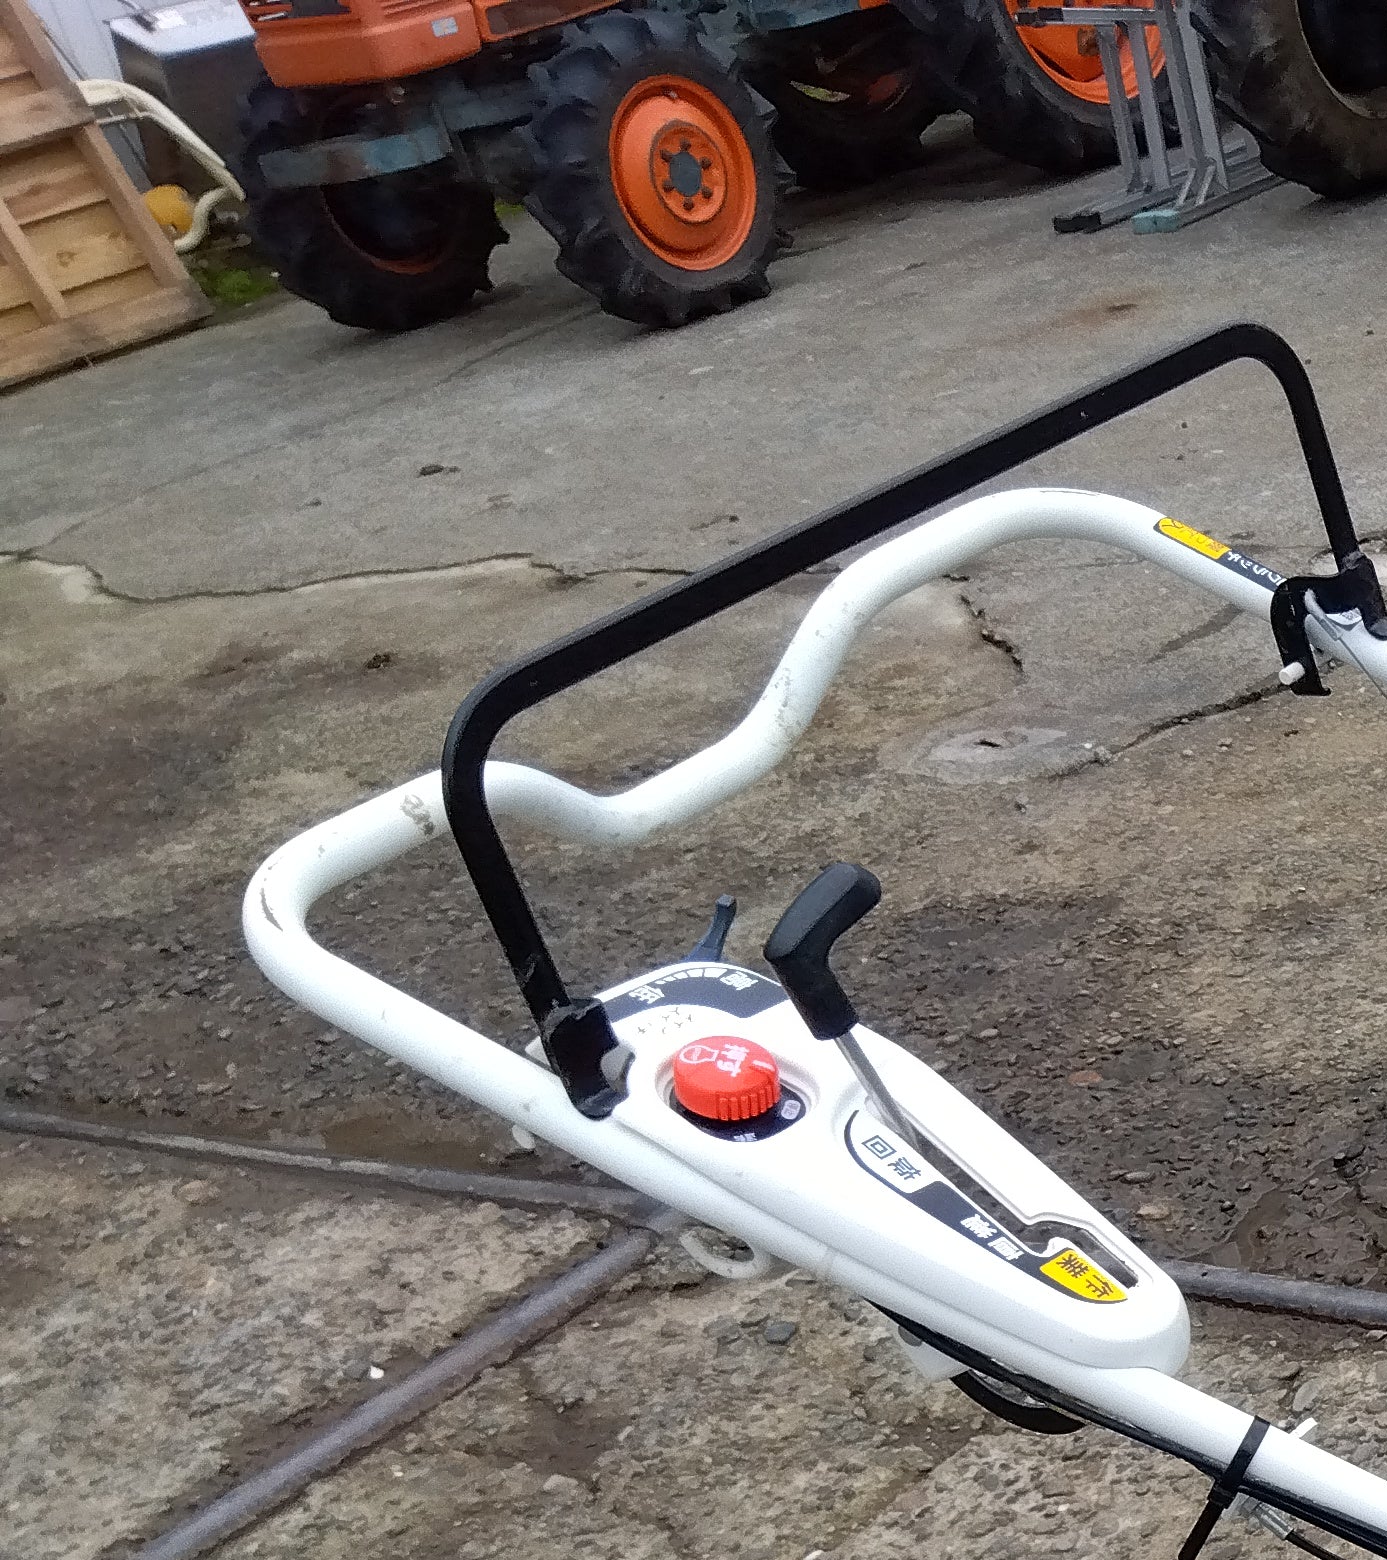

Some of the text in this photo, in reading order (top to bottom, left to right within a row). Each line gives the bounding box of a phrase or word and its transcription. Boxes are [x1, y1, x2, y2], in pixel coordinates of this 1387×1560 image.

[1228, 550, 1288, 587] クラッチ
[861, 1134, 922, 1181] 旋回
[1056, 1253, 1114, 1299] 作業
